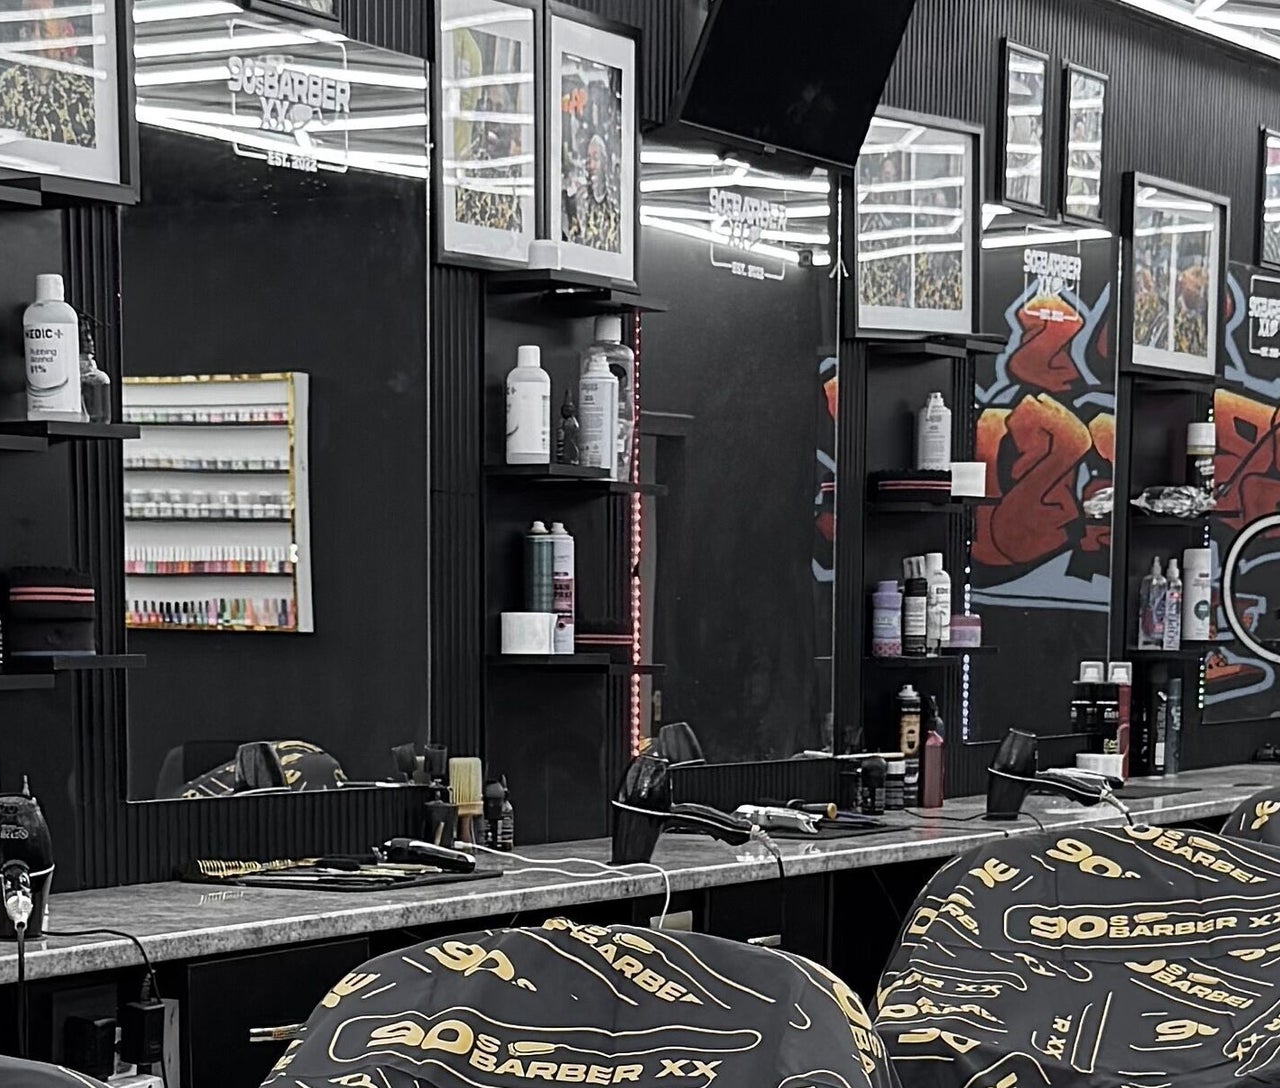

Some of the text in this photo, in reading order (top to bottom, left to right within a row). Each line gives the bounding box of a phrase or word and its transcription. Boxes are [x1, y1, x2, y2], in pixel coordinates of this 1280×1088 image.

[1108, 916, 1238, 940] BARBER
[468, 1049, 645, 1086] BARBER
[656, 1058, 723, 1082] XX
